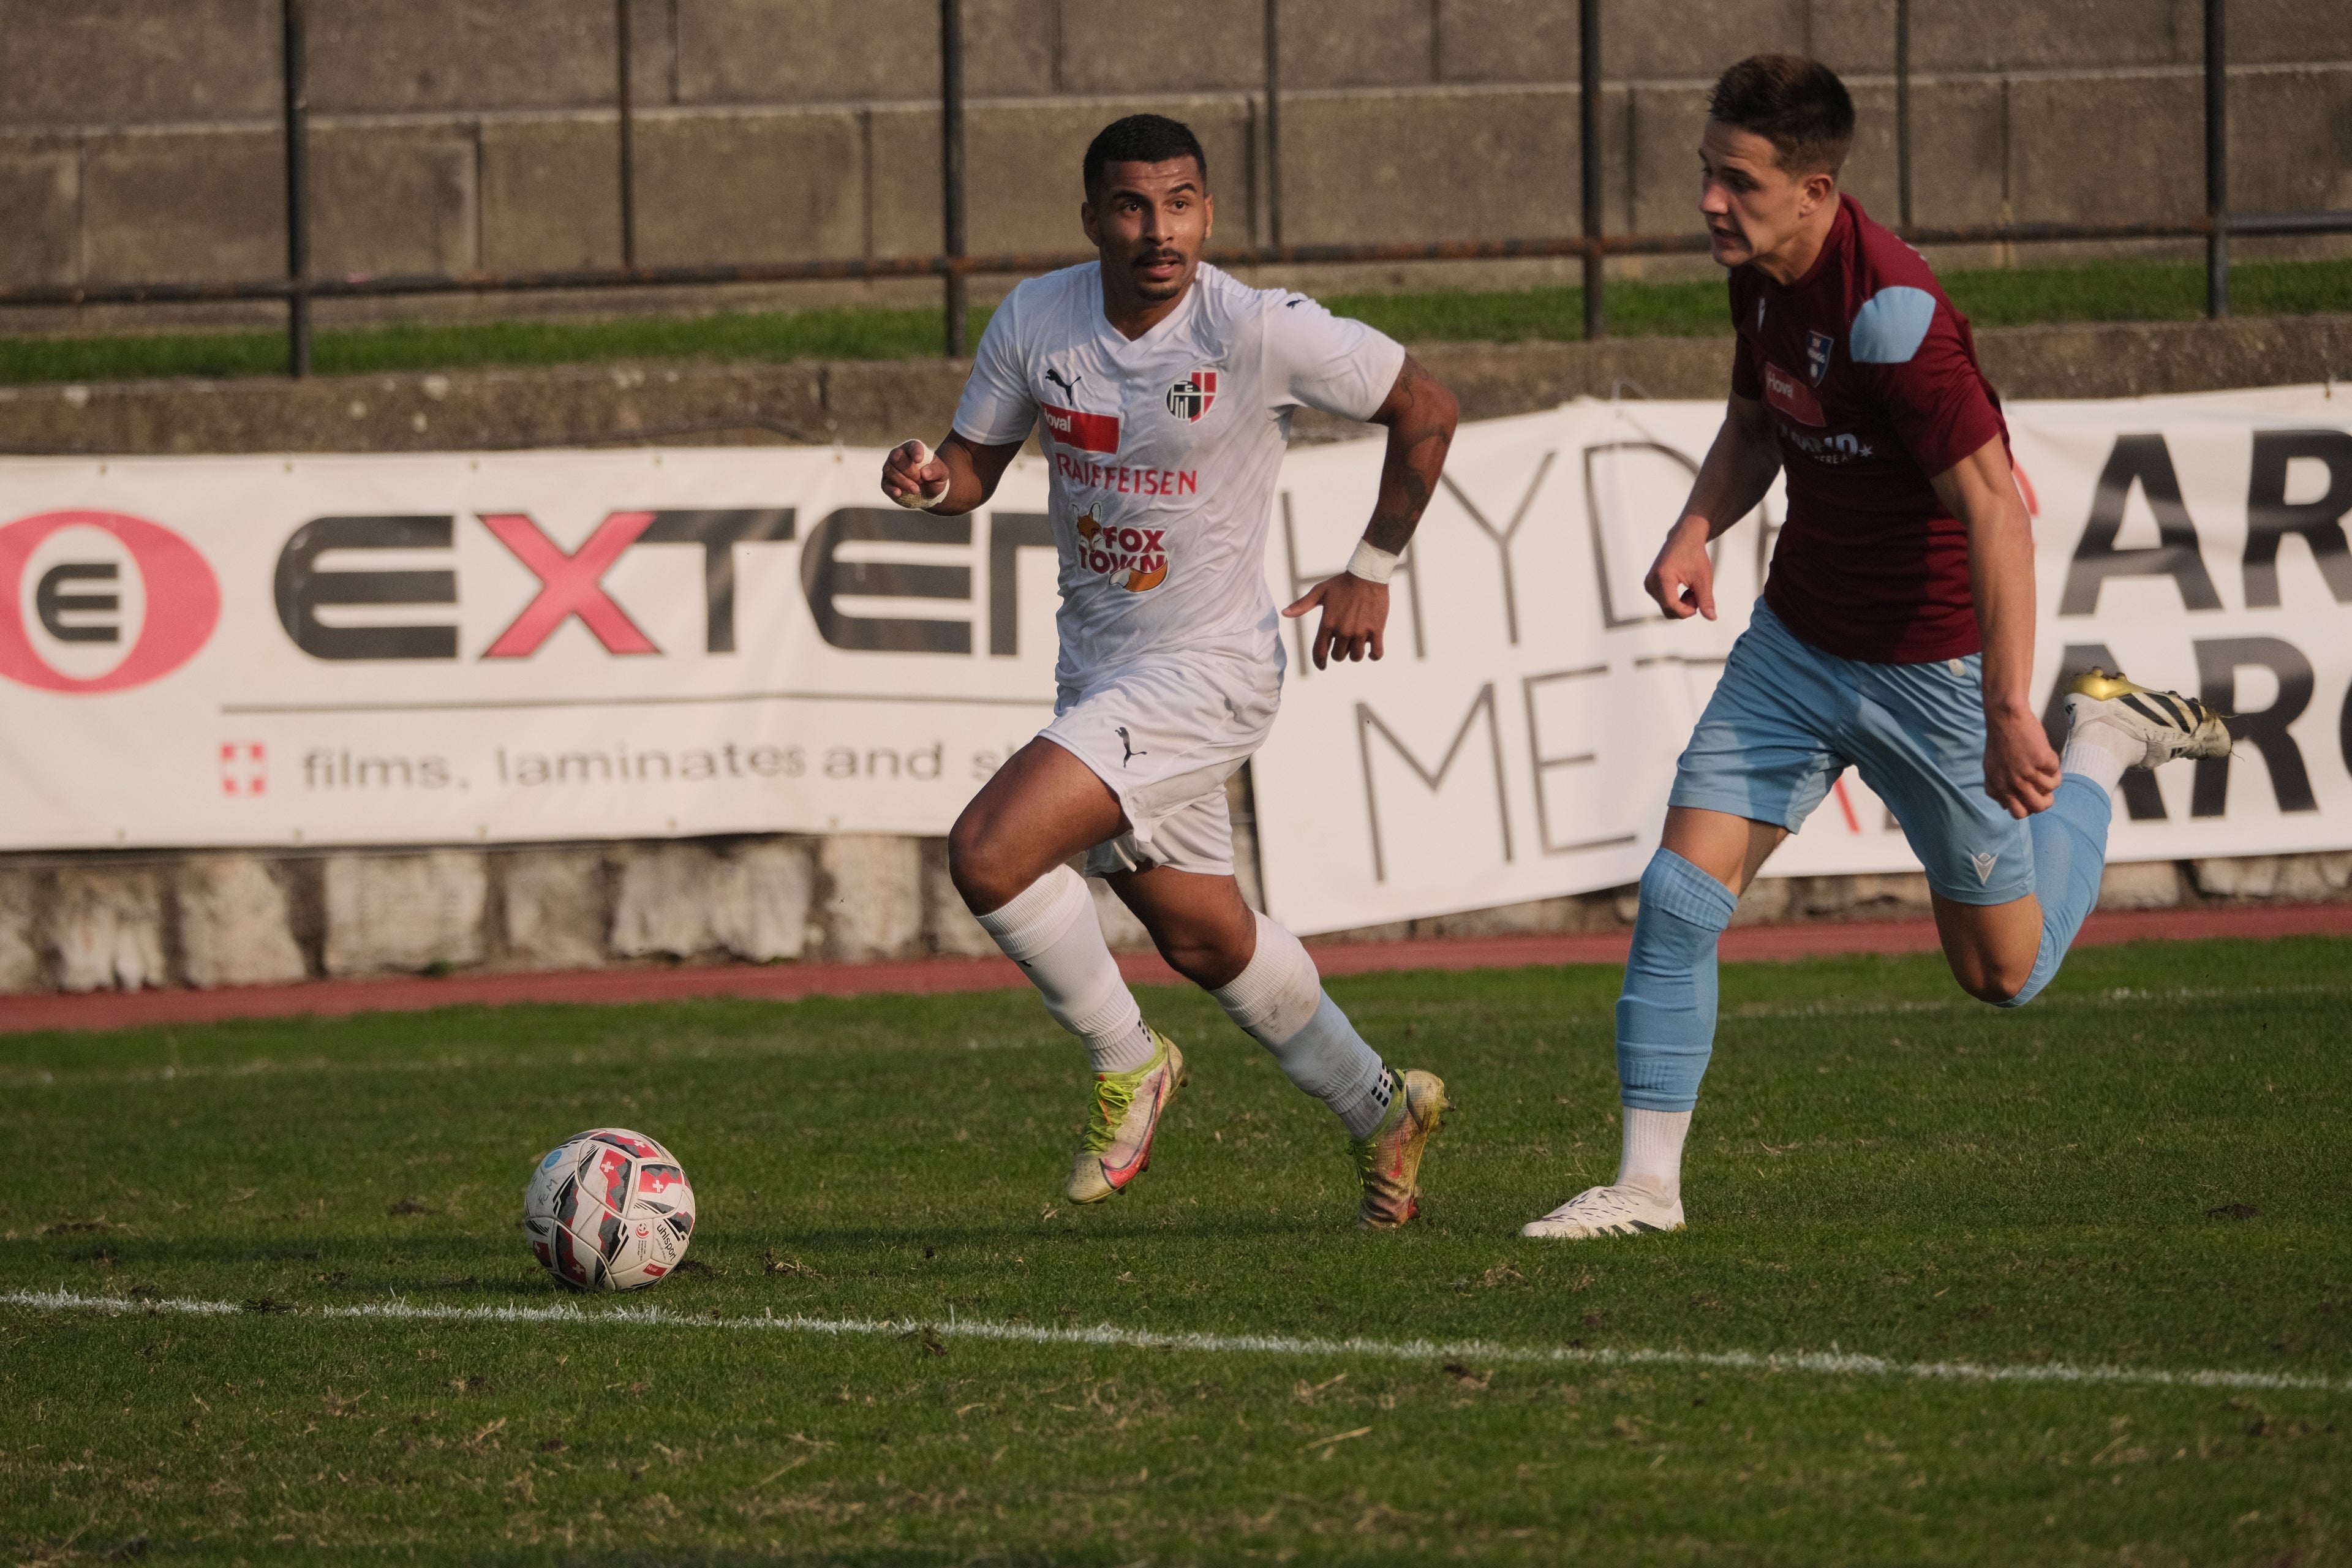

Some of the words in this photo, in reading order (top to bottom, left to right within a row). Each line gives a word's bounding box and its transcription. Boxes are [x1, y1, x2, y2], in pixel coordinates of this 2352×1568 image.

[1055, 453, 1197, 495] RAIFFEISEN
[1103, 526, 1166, 553] FOX
[1079, 544, 1166, 575] TOWN
[495, 741, 807, 786] laminates
[823, 739, 944, 782] and
[657, 1224, 677, 1262] uhlsport
